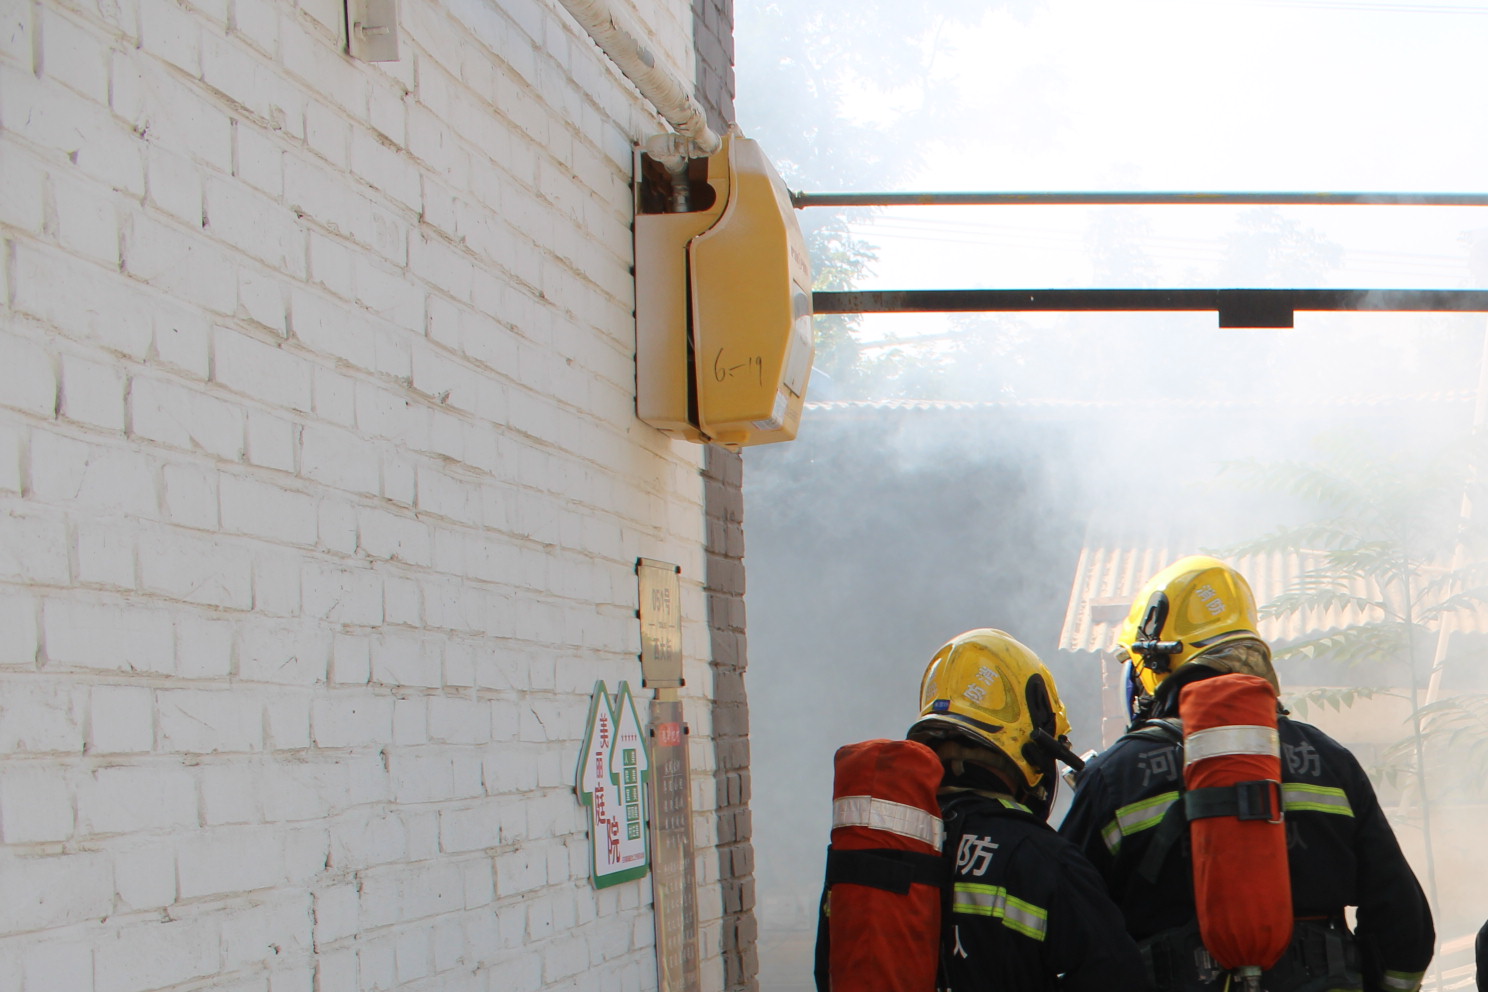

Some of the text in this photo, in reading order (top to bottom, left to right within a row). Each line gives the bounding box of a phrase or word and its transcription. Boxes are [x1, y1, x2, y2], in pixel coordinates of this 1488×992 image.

[1195, 584, 1226, 616] 消防
[963, 665, 999, 705] 消防
[594, 712, 621, 866] 美丽庭院
